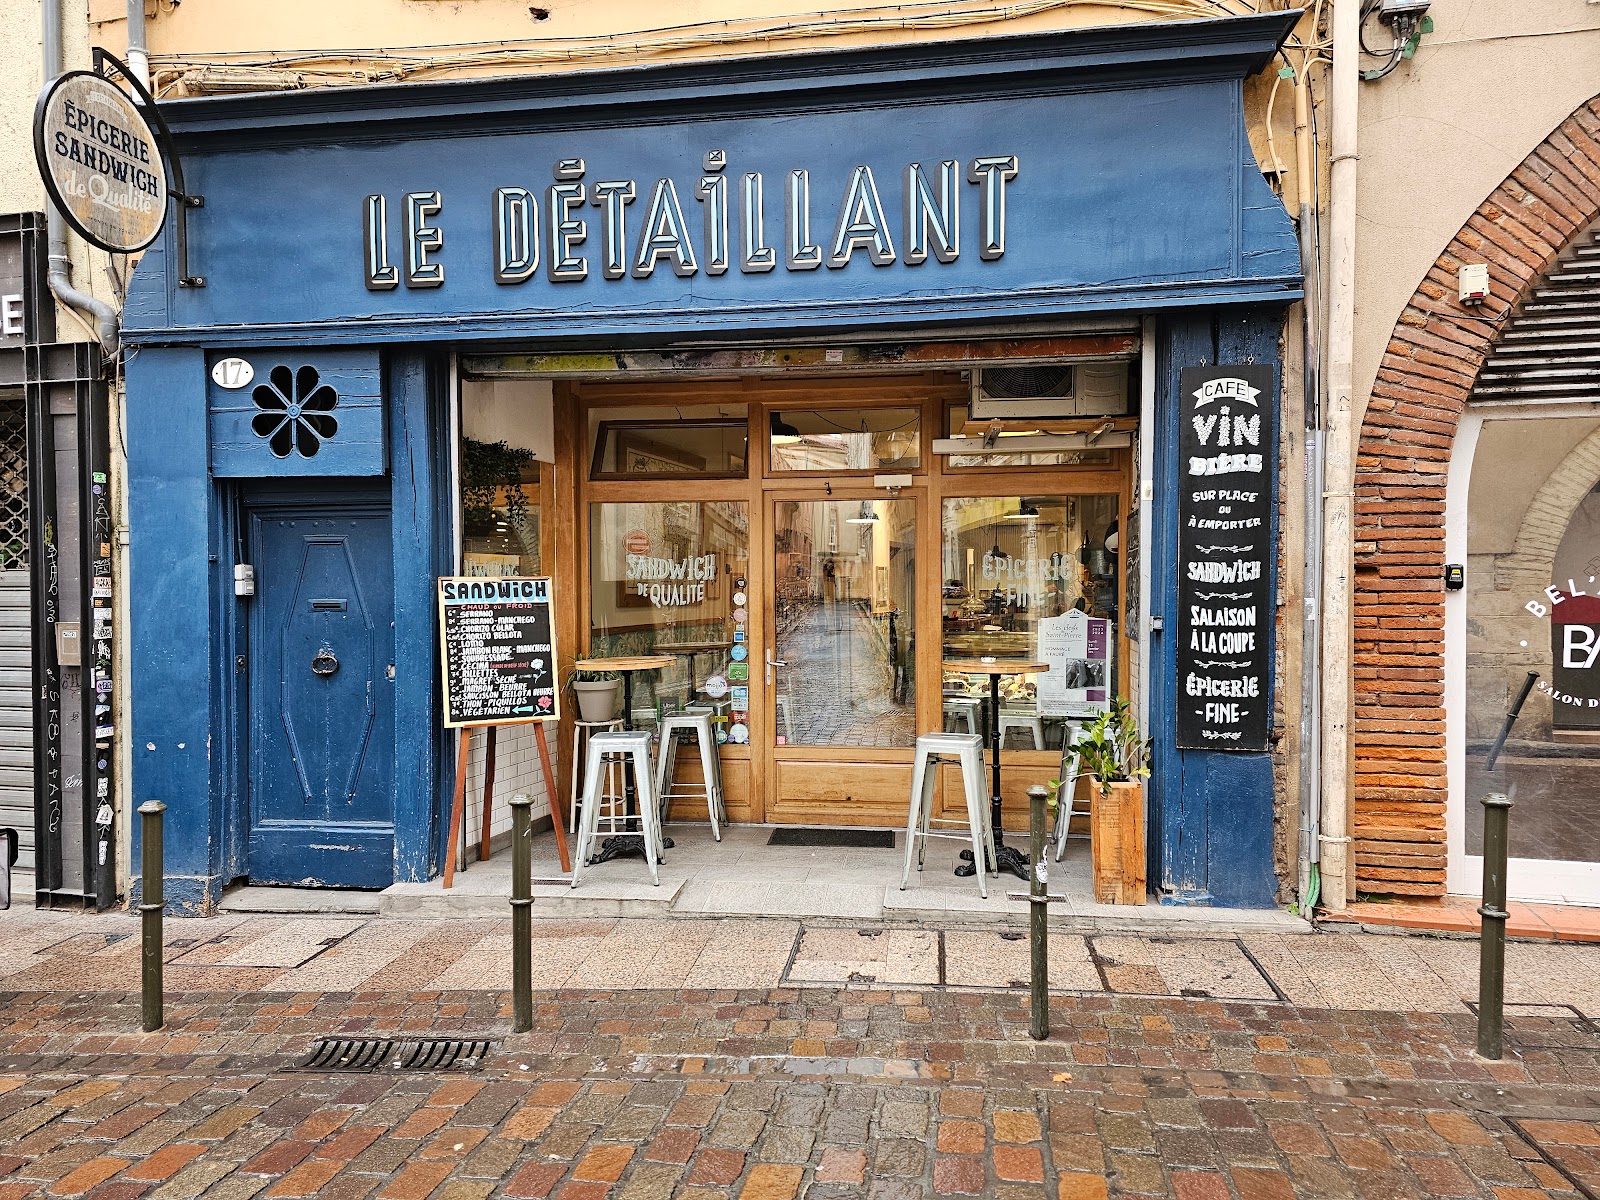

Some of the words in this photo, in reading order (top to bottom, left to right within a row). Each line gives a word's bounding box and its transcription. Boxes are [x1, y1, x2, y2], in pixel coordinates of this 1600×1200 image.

[64, 100, 150, 164] ÉPICERIE
[55, 131, 158, 198] SANDWICH
[64, 170, 86, 198] de
[88, 174, 152, 214] Qualité
[363, 191, 445, 290] LE
[492, 149, 1018, 285] DÉTAILLANT
[0, 294, 24, 335] E
[220, 362, 242, 384] 17
[1188, 452, 1262, 476] BIÈRE
[1192, 490, 1216, 502] SUR
[1219, 490, 1258, 503] PLACE
[1218, 505, 1232, 514] OU
[1188, 514, 1196, 527] À
[1198, 517, 1261, 530] EMPORTER
[626, 553, 715, 580] SANDWICH
[982, 550, 1073, 580] ÉPICERIE
[1187, 559, 1261, 584] SANDWICH
[637, 582, 649, 597] DE
[650, 580, 704, 608] QUALITÉ
[1007, 584, 1045, 608] FINE
[1525, 576, 1600, 618] BEL'
[460, 632, 491, 640] CHORIZO
[493, 631, 522, 639] BELLOTA
[1191, 629, 1199, 651] À
[1202, 631, 1217, 654] LA
[1219, 632, 1256, 654] COUPE
[461, 646, 491, 655] JAMBON
[516, 644, 550, 653] MANCHEGO
[462, 669, 498, 677] RILLETTES
[462, 677, 492, 685] MAGRET
[1186, 672, 1259, 698] ÉPICERIE
[463, 691, 499, 700] SAUCISSON
[502, 689, 531, 698] BELLOTA
[499, 683, 528, 691] BEURRE
[1537, 680, 1583, 707] SALON
[488, 697, 527, 706] PIQUILLOS
[1205, 702, 1239, 724] FINE
